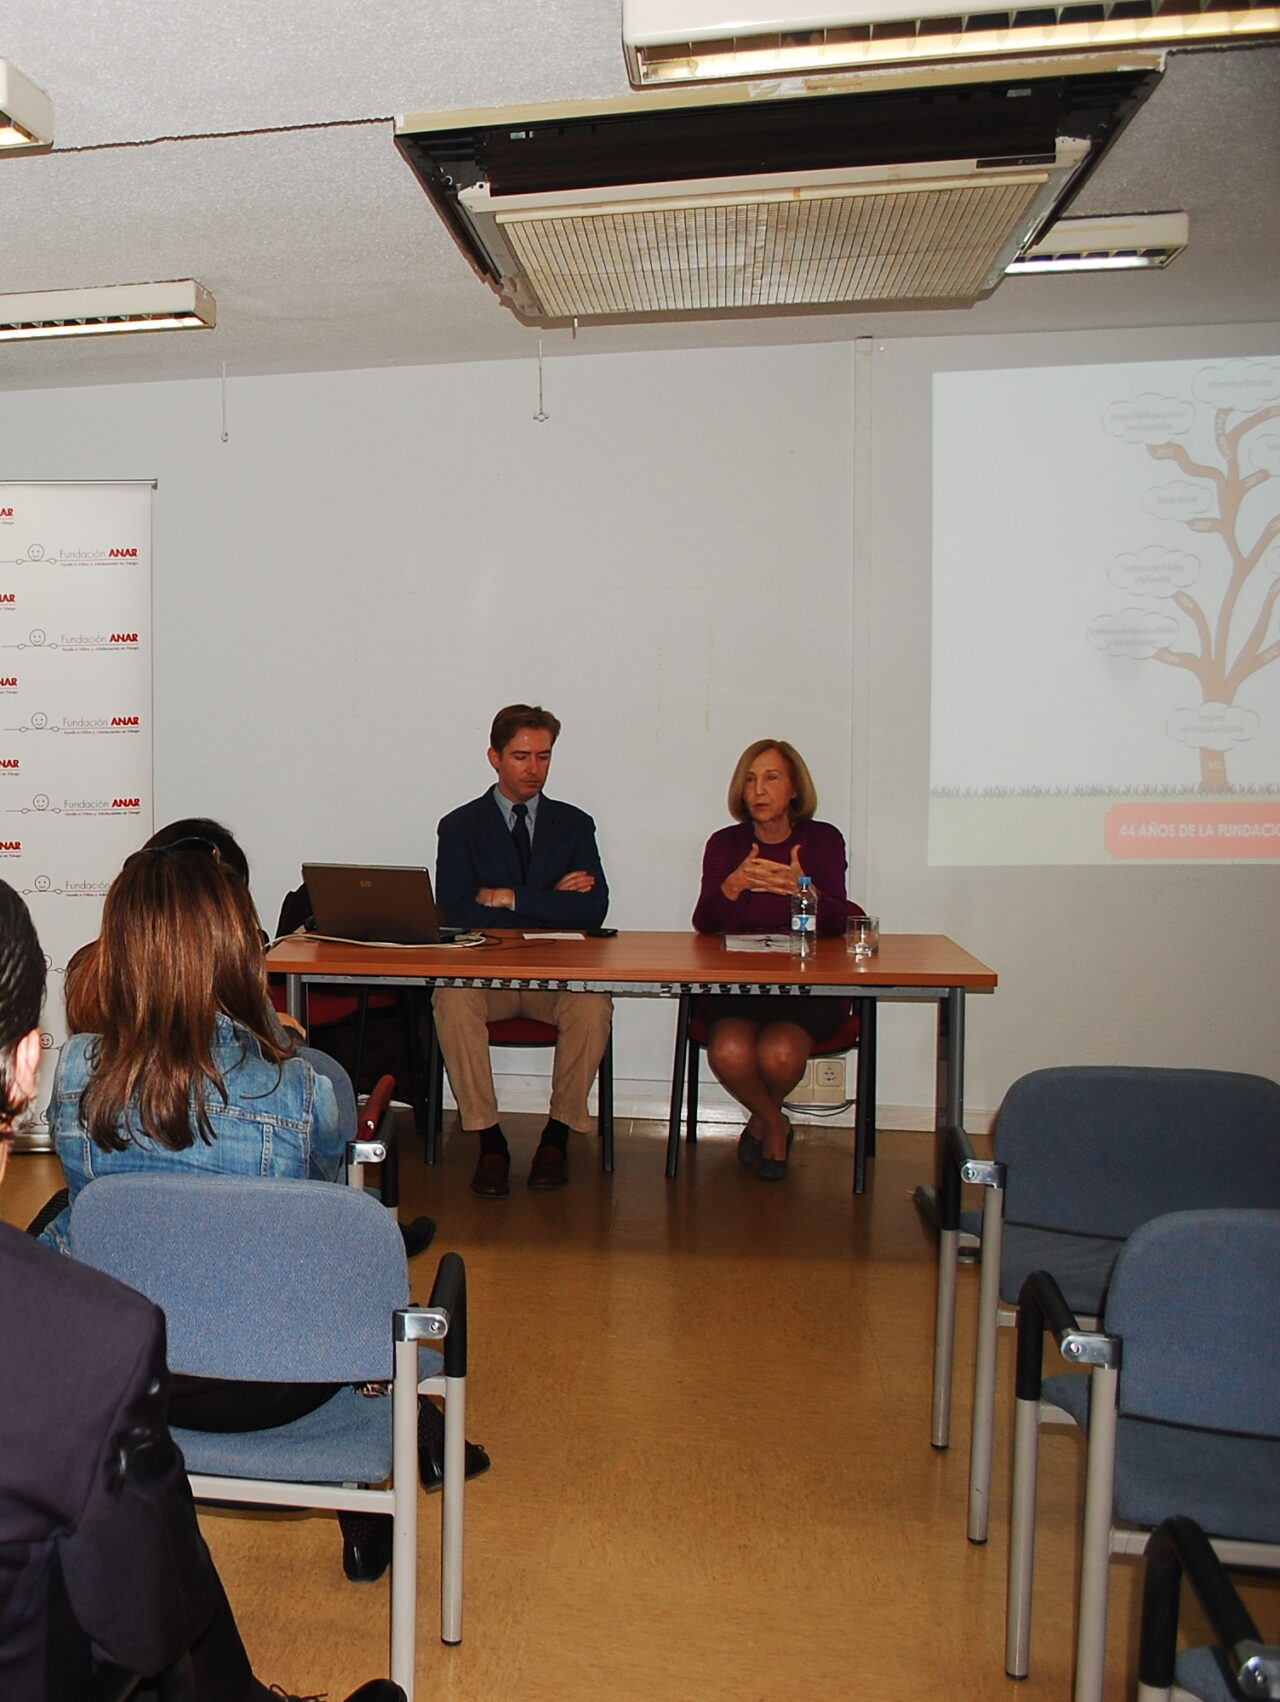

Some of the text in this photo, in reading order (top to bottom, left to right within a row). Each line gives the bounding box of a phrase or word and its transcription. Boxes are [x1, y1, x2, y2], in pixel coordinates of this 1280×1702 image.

[108, 548, 138, 558] ANAR
[109, 633, 138, 643] ANAR
[110, 716, 139, 726] ANAR
[111, 798, 140, 807] ANAR
[1118, 823, 1135, 837] 44
[1138, 821, 1175, 837] AÑOS
[1179, 824, 1195, 837] DE
[1198, 824, 1214, 837] LA
